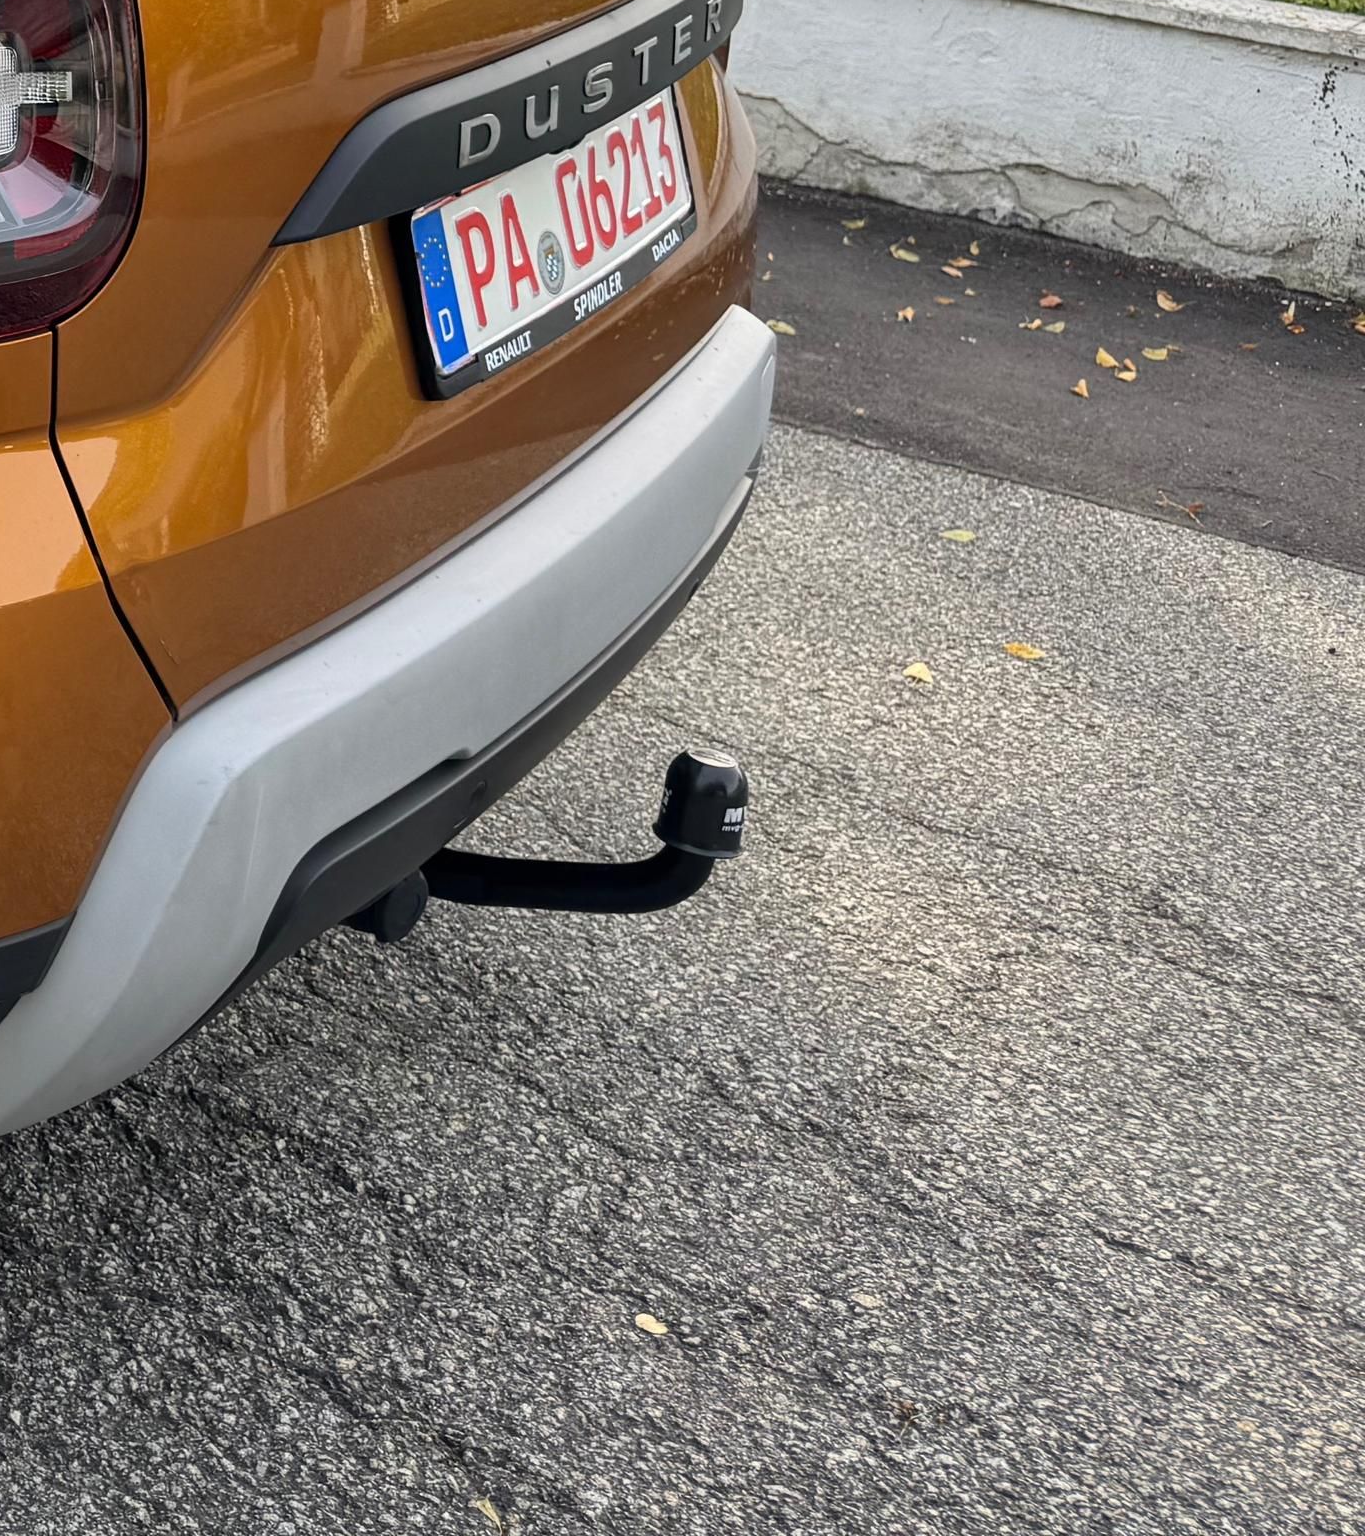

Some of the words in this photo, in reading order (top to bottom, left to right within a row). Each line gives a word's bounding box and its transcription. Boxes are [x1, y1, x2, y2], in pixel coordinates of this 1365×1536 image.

[455, 191, 540, 330] PA
[555, 98, 677, 270] 06213
[438, 308, 454, 342] D
[484, 330, 533, 372] RENAULT
[573, 270, 623, 321] SPINDLER
[651, 228, 681, 262] DACIA
